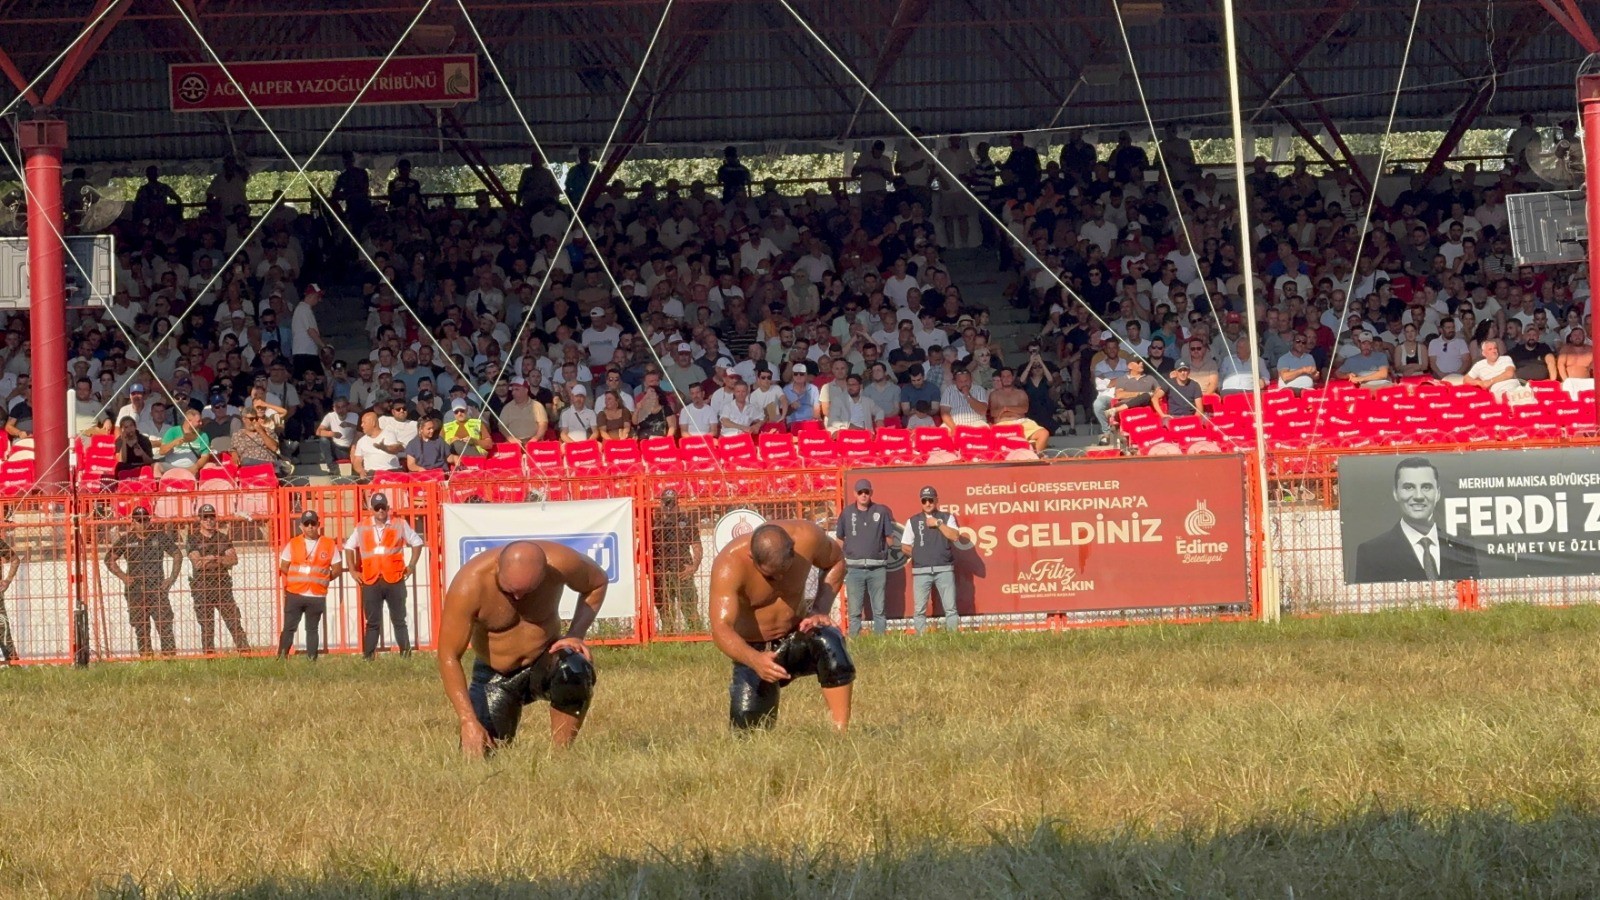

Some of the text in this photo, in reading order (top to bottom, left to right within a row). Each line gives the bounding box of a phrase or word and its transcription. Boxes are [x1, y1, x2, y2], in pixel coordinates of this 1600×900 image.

[249, 81, 293, 95] ALPER
[297, 75, 366, 94] YAZOĞLU
[369, 71, 437, 91] TRİBÜNÜ
[966, 480, 1120, 496] DEĞERLİ GÜREŞSEVERLER
[1459, 477, 1504, 489] MERHUM
[964, 500, 1040, 515] MEYDANI
[1044, 495, 1148, 512] KIRKPINAR’A
[1445, 492, 1568, 537] FERDİ
[1007, 511, 1163, 548] GELDİNİZ
[1176, 538, 1229, 555] Edirne
[1487, 538, 1600, 555] RAHMET VE ÖZL
[1030, 558, 1076, 585] Filiz
[1001, 580, 1095, 594] GENCAN AKIN
